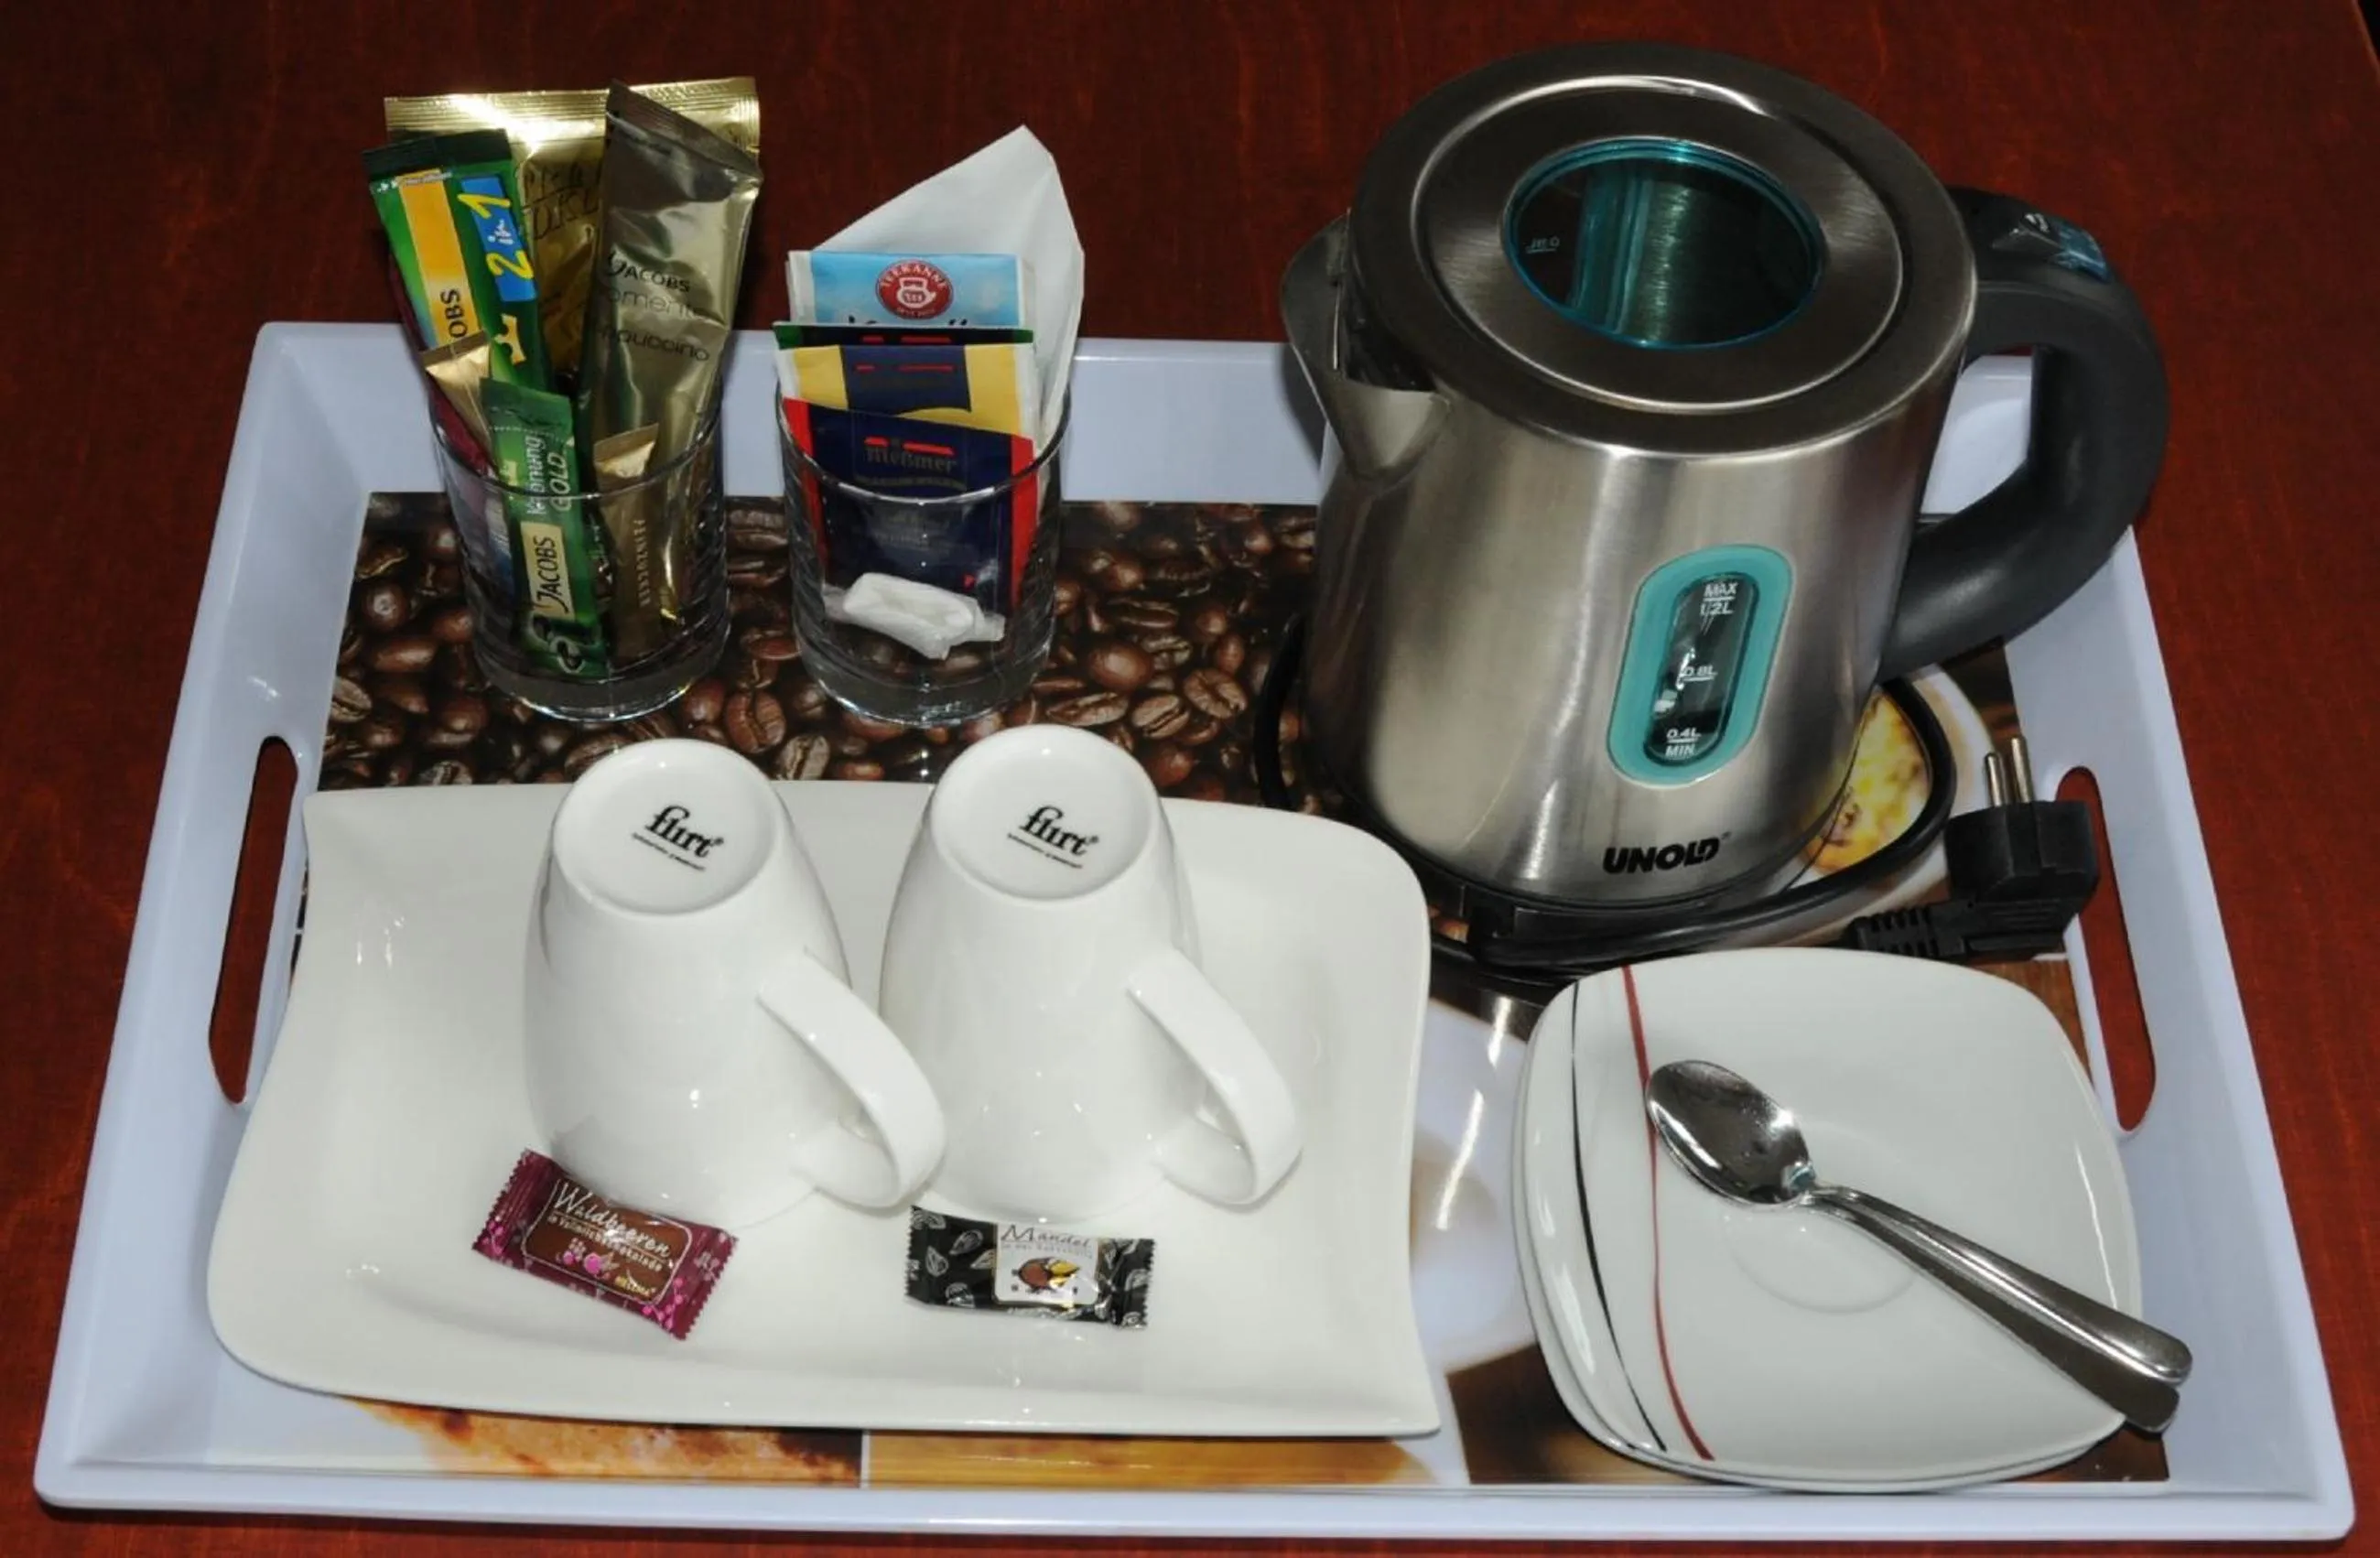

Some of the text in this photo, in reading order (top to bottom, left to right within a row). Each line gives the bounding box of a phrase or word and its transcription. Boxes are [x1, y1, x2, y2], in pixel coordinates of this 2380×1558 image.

[456, 192, 535, 280] 2 in 1
[604, 251, 691, 293] JACOBS
[438, 288, 468, 339] OBS
[606, 287, 699, 320] oment
[547, 451, 573, 513] GOLD
[534, 536, 569, 613] JACOBS
[1703, 582, 1738, 597] MAX
[1665, 744, 1695, 759] MIN
[644, 805, 711, 858] flirt
[1018, 805, 1087, 857] flirt
[1602, 837, 1720, 874] UNOLD
[1001, 1224, 1090, 1248] Mandel
